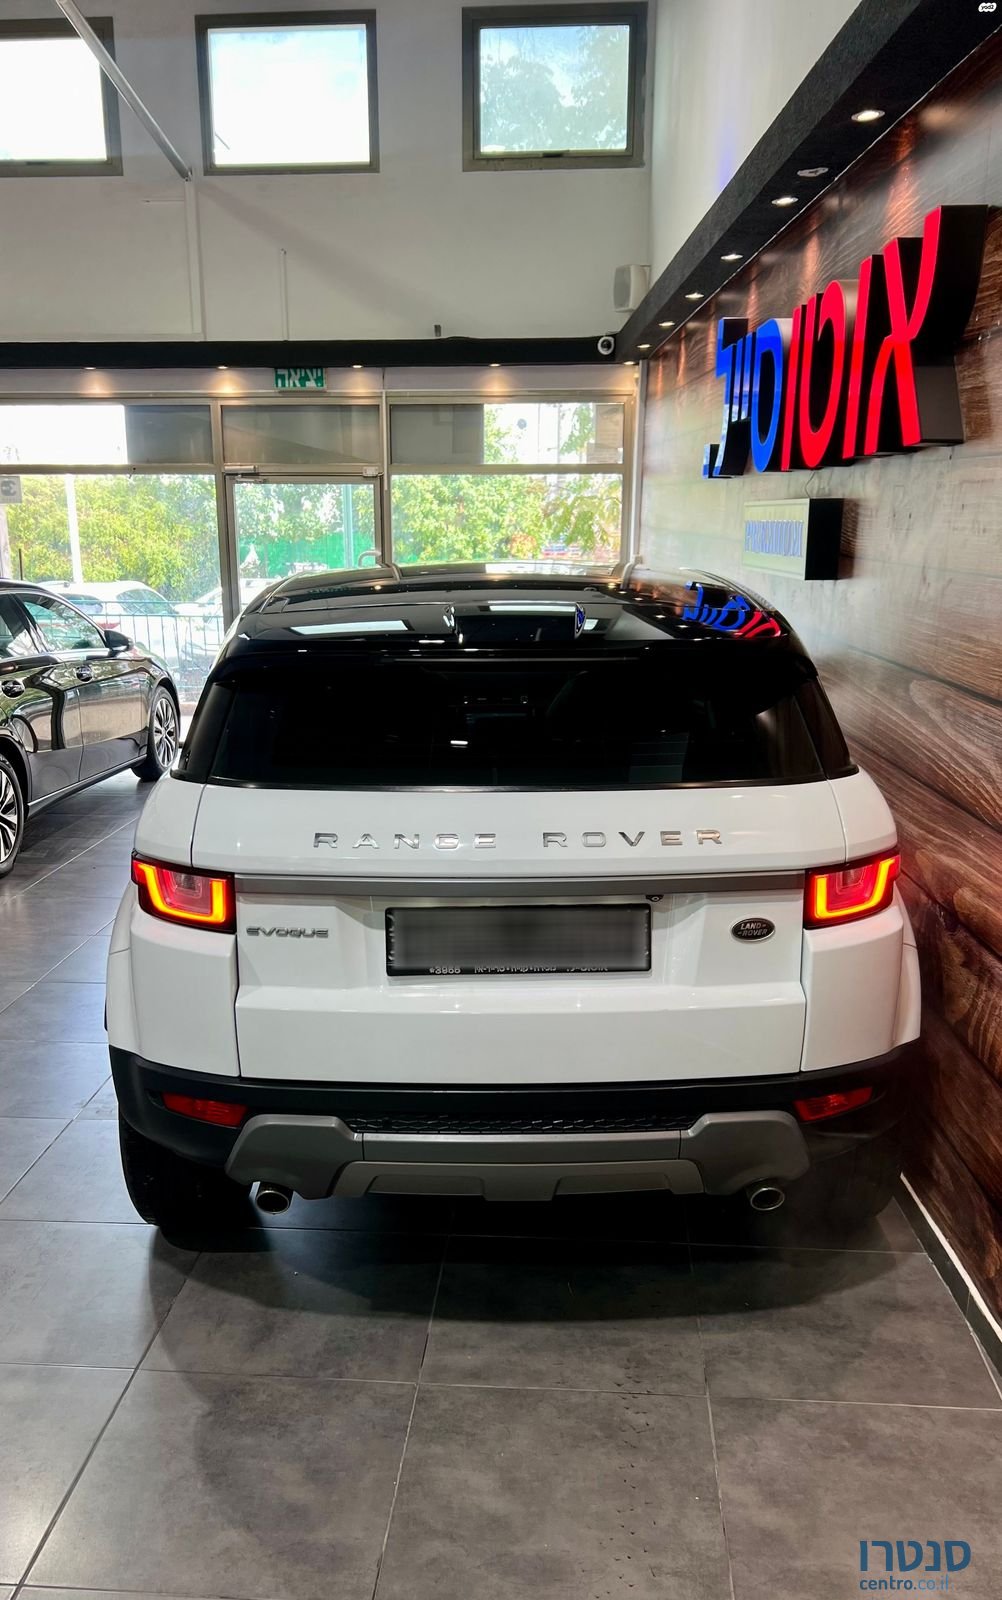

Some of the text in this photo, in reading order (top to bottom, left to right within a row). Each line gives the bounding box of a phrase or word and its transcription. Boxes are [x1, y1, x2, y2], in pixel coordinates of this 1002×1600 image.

[313, 829, 723, 849] RANGE ROVER
[246, 926, 329, 939] EVOQUE
